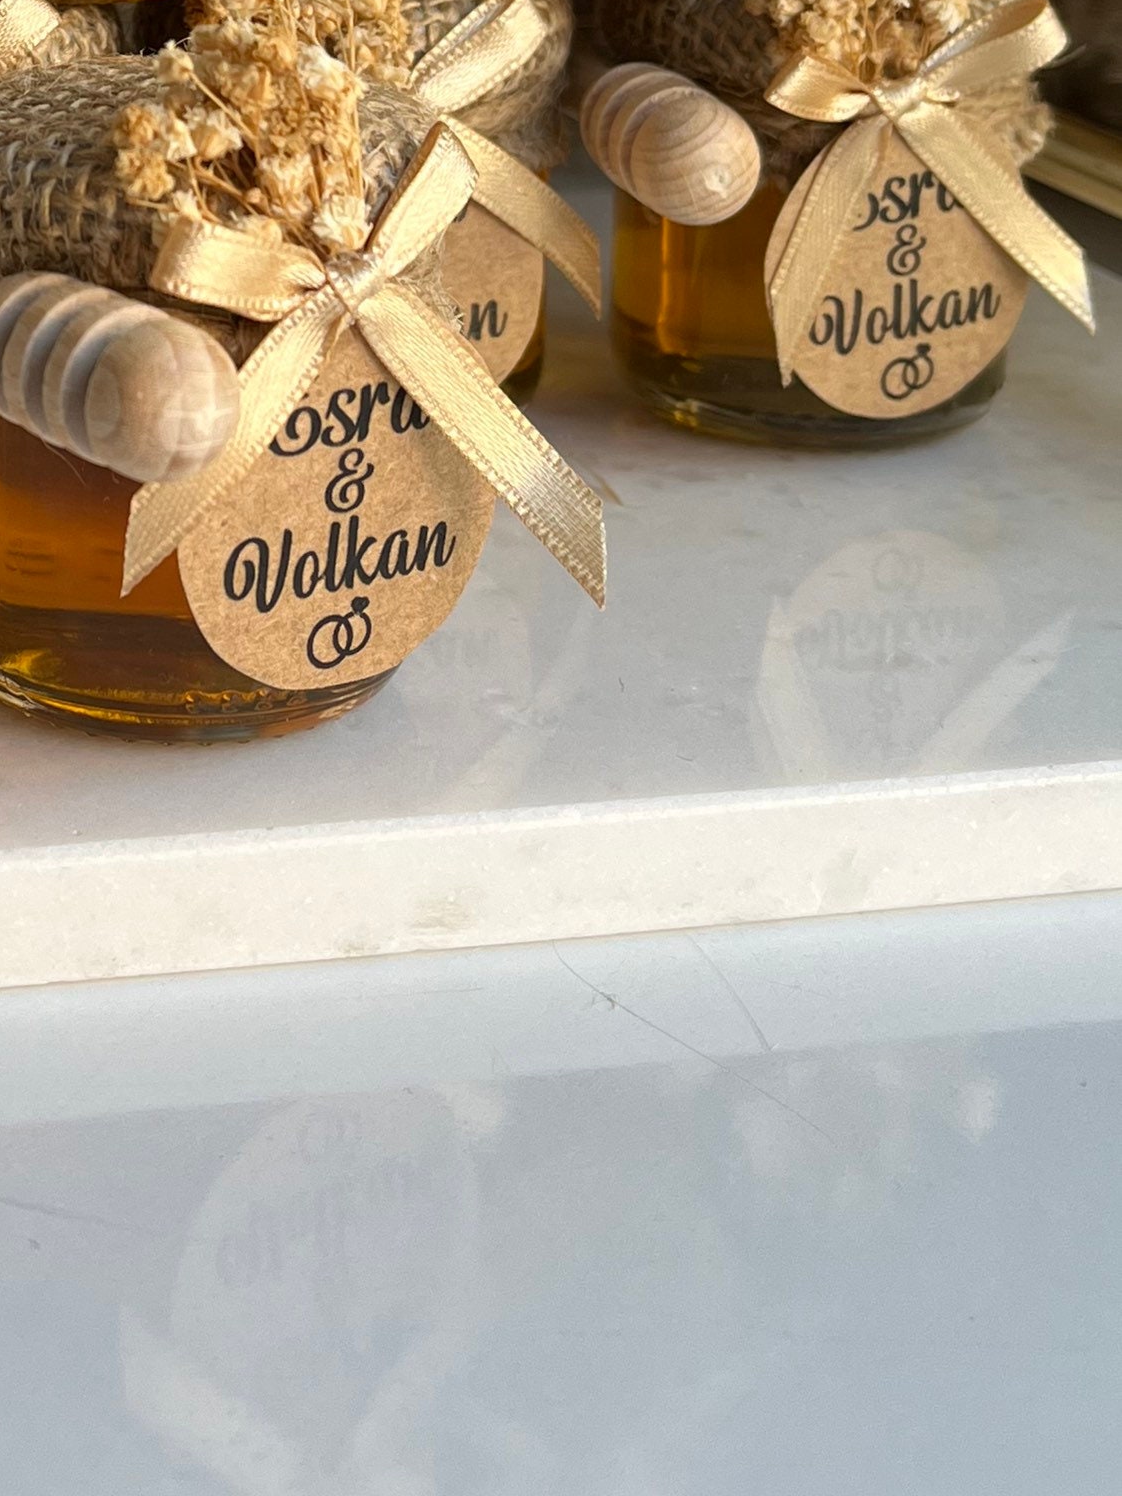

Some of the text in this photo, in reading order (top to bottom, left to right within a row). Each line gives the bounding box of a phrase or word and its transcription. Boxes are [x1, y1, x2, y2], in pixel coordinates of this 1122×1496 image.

[852, 171, 965, 232] sr
[886, 223, 926, 276] &
[809, 278, 1001, 355] Volkan
[324, 447, 375, 514] &
[223, 515, 456, 614] Volkan
